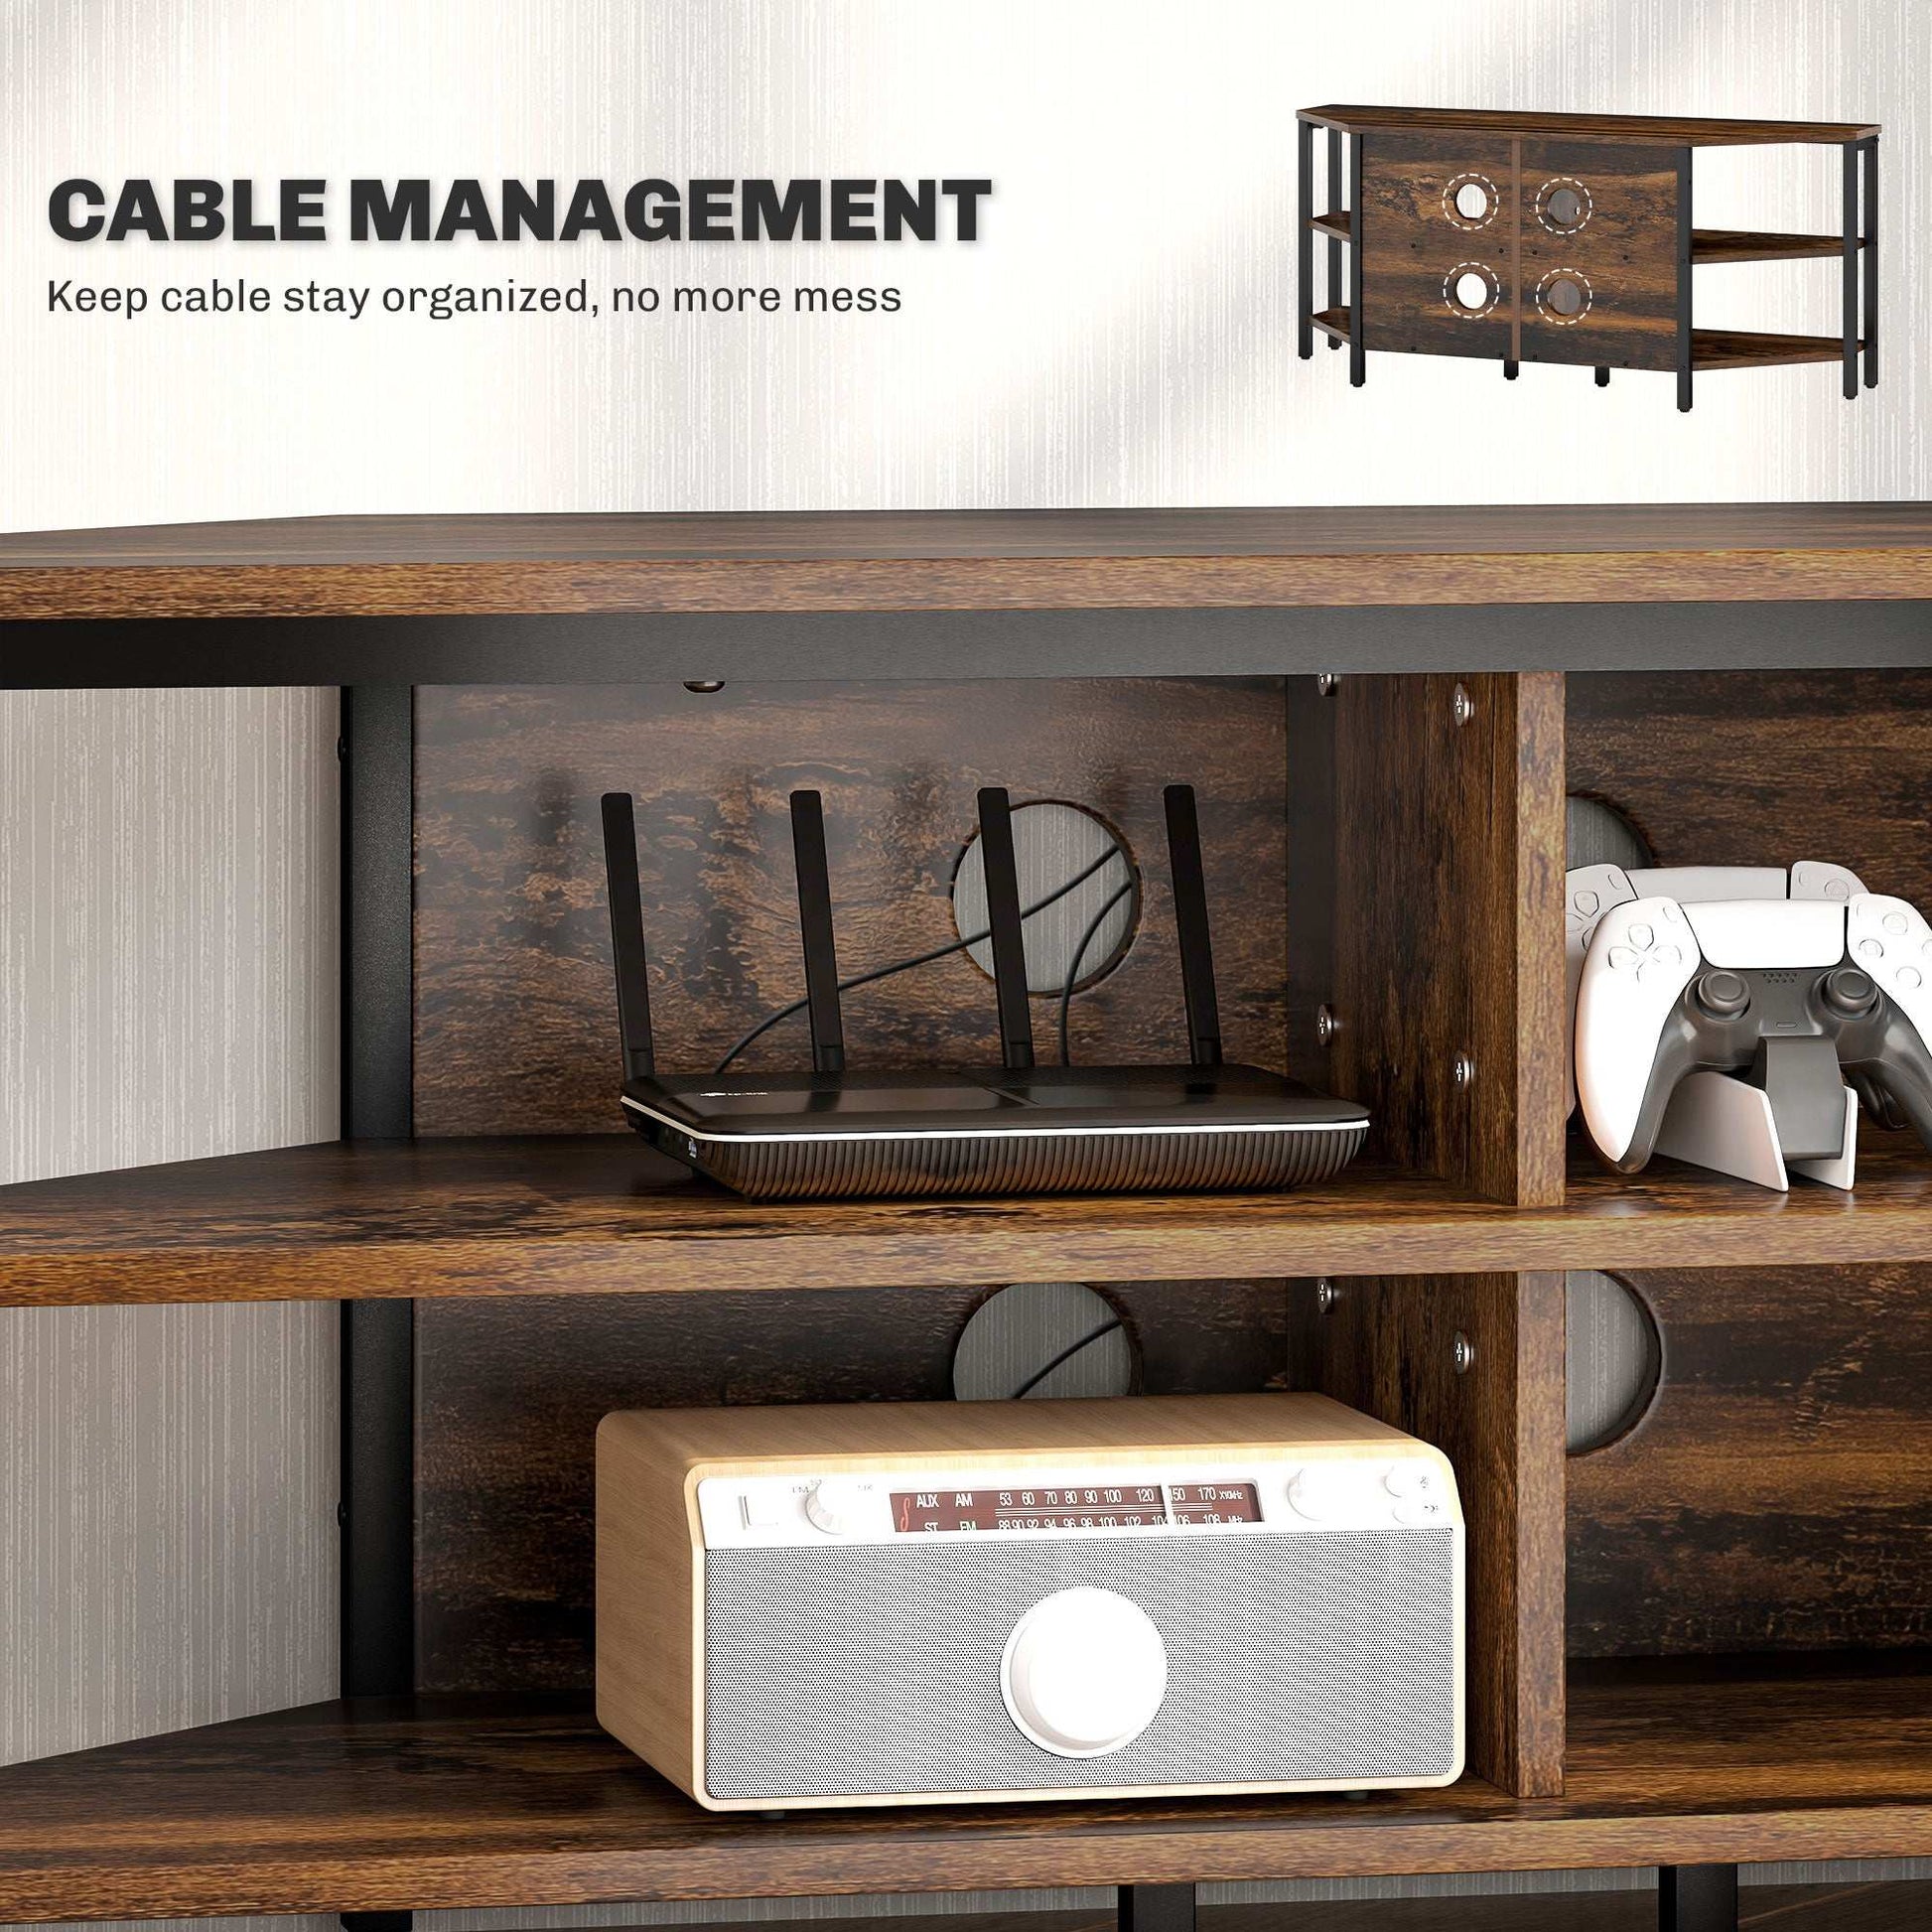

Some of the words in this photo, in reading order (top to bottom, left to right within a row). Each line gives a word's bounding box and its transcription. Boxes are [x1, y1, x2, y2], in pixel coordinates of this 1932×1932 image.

[915, 1494, 940, 1508] AUX
[955, 1493, 973, 1507] AM
[999, 1492, 1013, 1506] 53
[1022, 1491, 1035, 1506] 60
[1044, 1491, 1058, 1505] 70
[1064, 1490, 1078, 1505] 80
[1084, 1490, 1098, 1504] 90
[1104, 1489, 1122, 1503] 100
[1136, 1488, 1154, 1502] 120
[1197, 1486, 1217, 1501] 170
